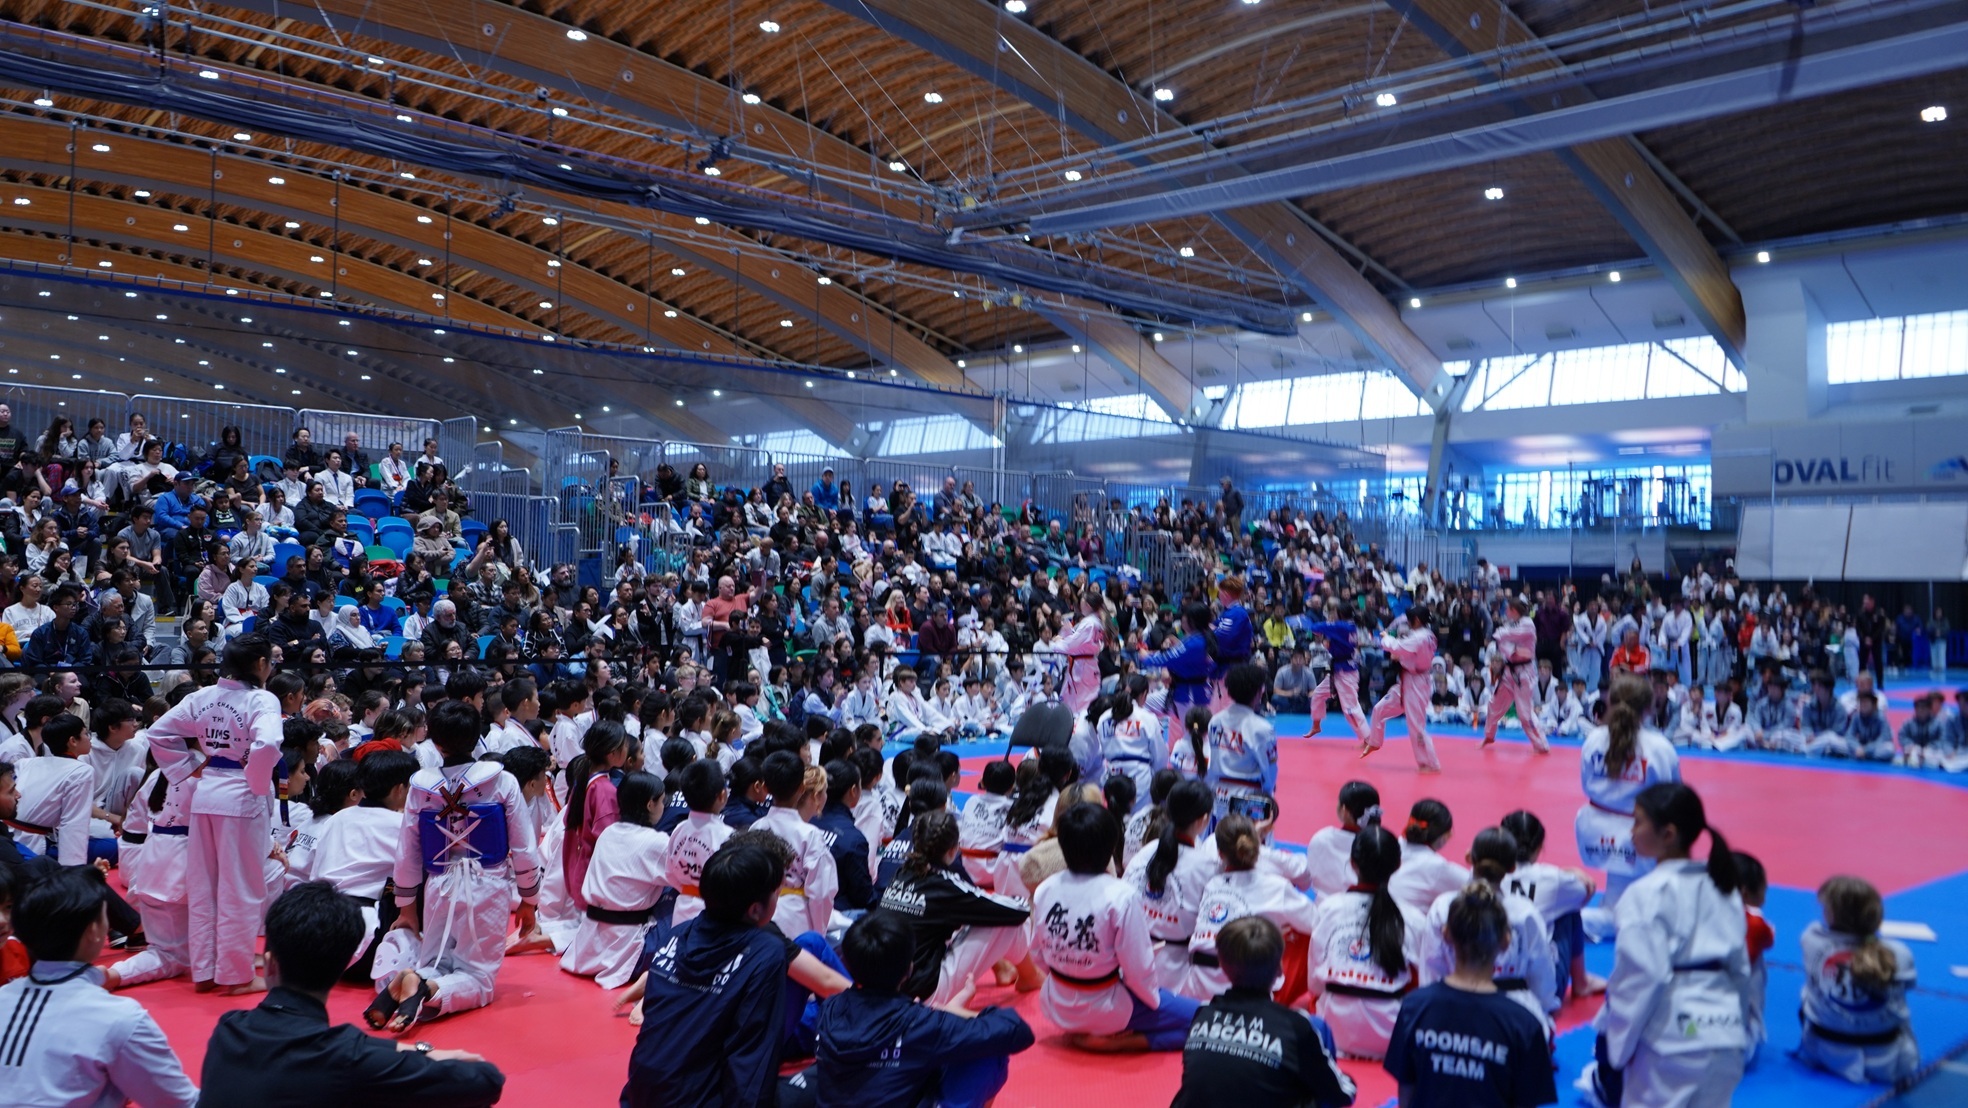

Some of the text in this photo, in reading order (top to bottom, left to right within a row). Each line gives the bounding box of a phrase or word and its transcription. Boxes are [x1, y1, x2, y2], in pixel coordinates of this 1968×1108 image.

[217, 701, 244, 729] CHAMPION
[205, 727, 230, 741] LIMS
[1213, 1011, 1264, 1032] TEAM
[1189, 1021, 1283, 1057] CASCADIA
[1415, 1029, 1509, 1066] POOMSAE
[1204, 1042, 1282, 1070] PERFORMANCE
[1431, 1053, 1485, 1081] TEAM
